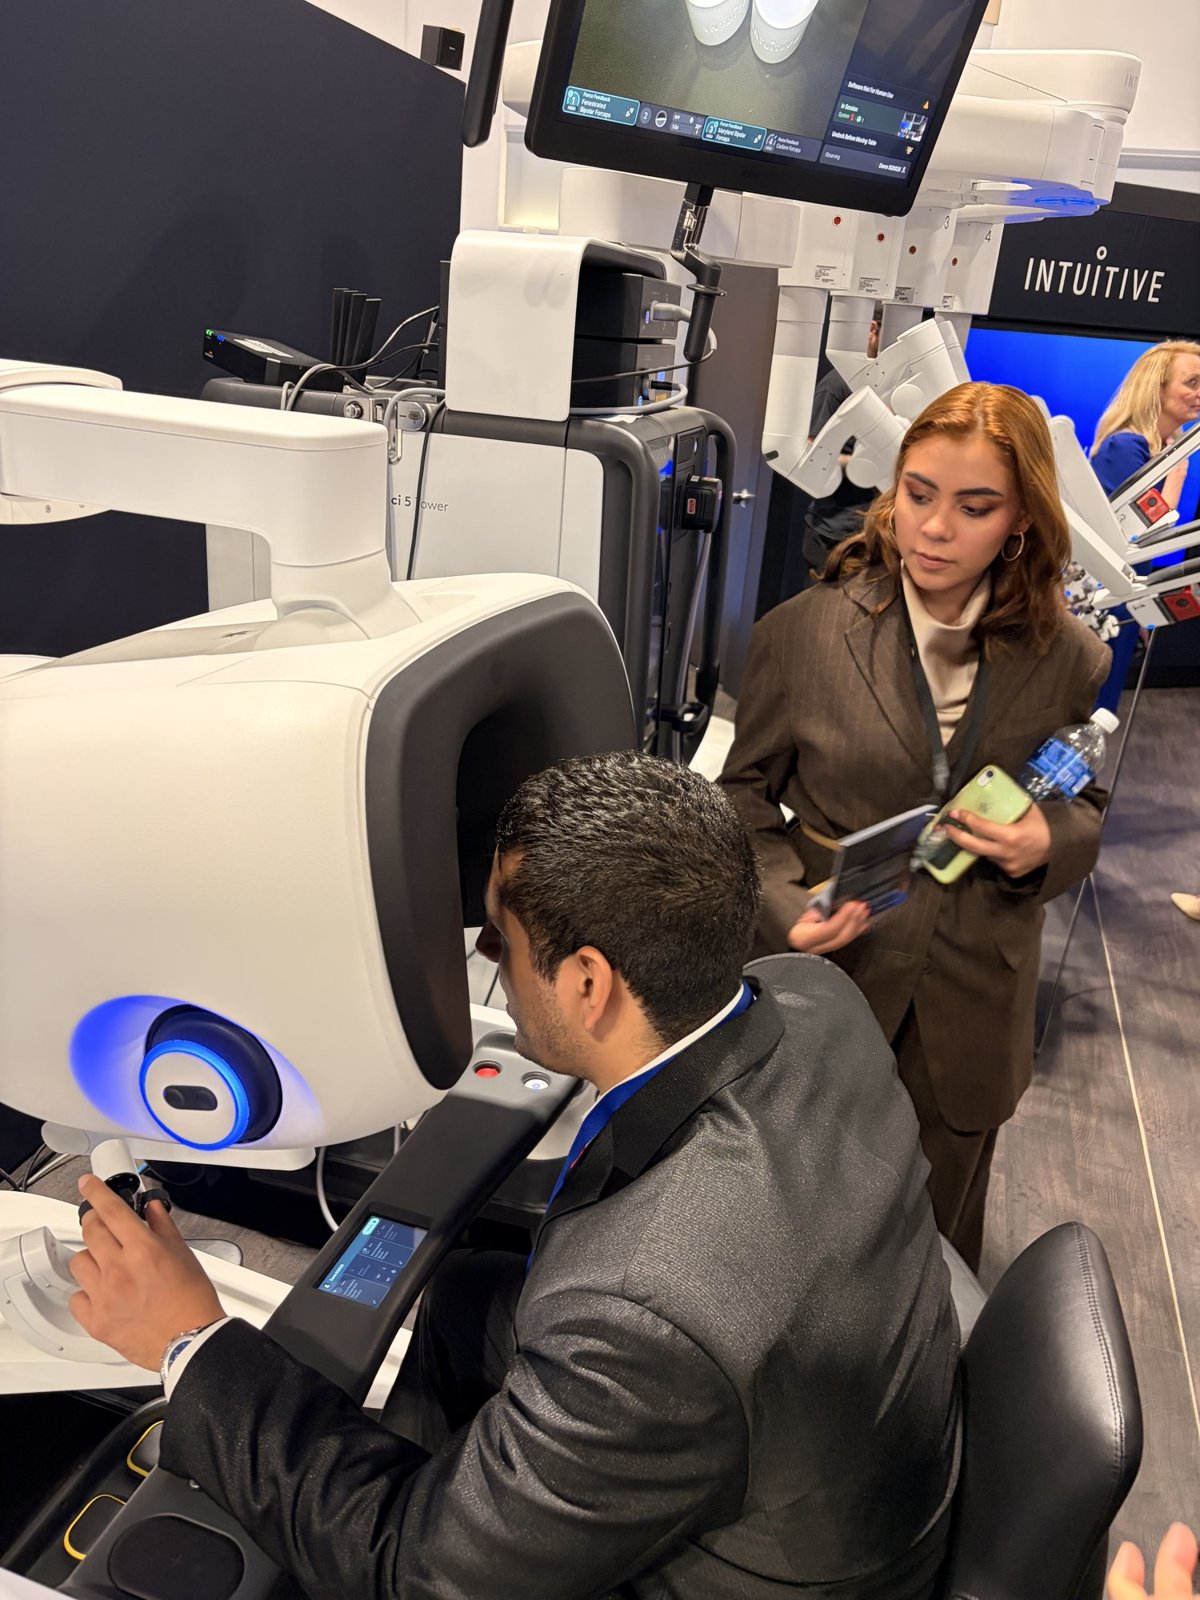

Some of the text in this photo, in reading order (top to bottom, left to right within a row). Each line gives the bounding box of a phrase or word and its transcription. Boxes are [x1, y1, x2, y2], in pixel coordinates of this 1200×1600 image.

[581, 98, 607, 110] Fenestrated
[593, 94, 611, 103] Feedback
[580, 106, 612, 119] Bipolar Forceps
[715, 134, 731, 143] Forceps
[717, 127, 747, 139] Maryland Bipolar
[944, 215, 950, 229] 3
[984, 230, 992, 243] 4
[1024, 246, 1166, 303] INTUITIVE
[404, 496, 411, 507] 5
[417, 497, 448, 511] ower
